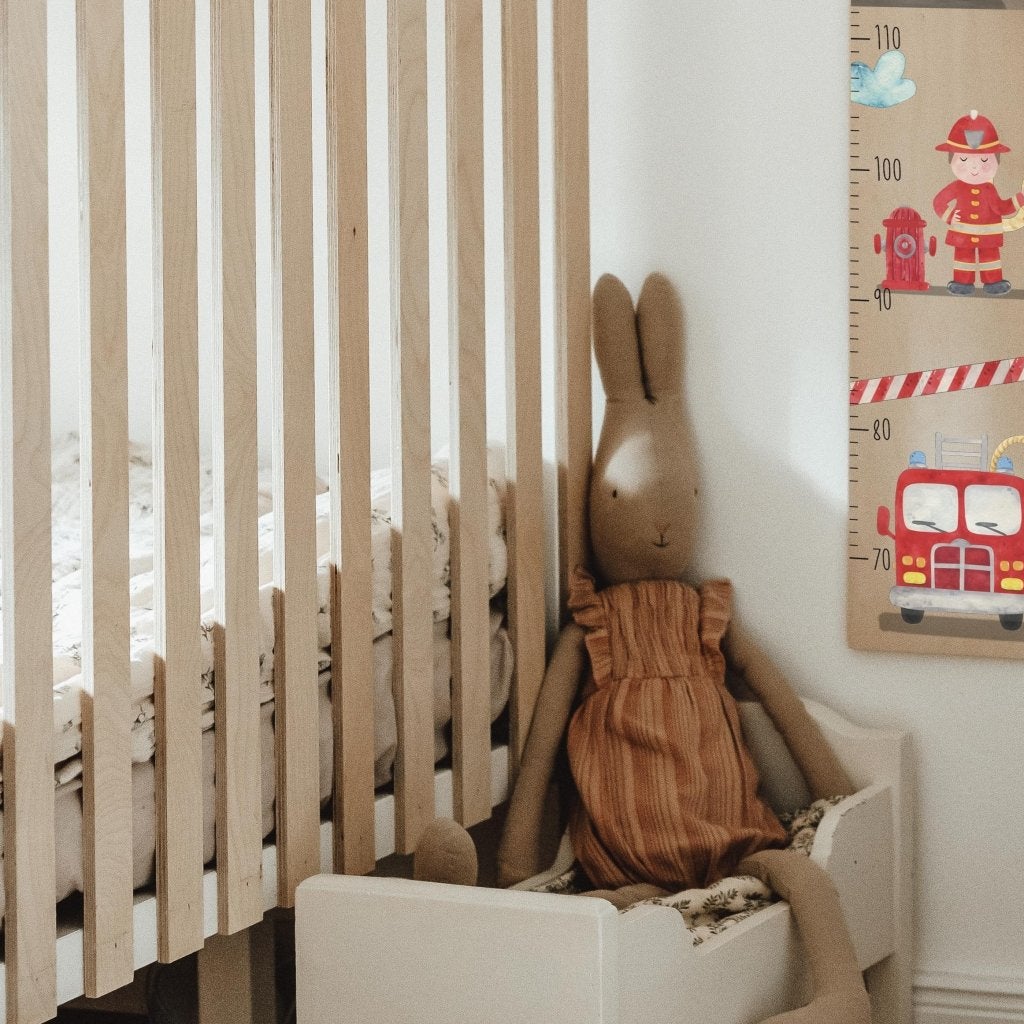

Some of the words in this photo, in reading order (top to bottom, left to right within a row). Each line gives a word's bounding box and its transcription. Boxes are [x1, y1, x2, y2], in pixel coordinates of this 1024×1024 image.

[875, 24, 901, 50] 110
[874, 155, 902, 182] 100
[873, 287, 892, 312] 90
[872, 417, 891, 441] 80
[872, 547, 891, 571] 70
